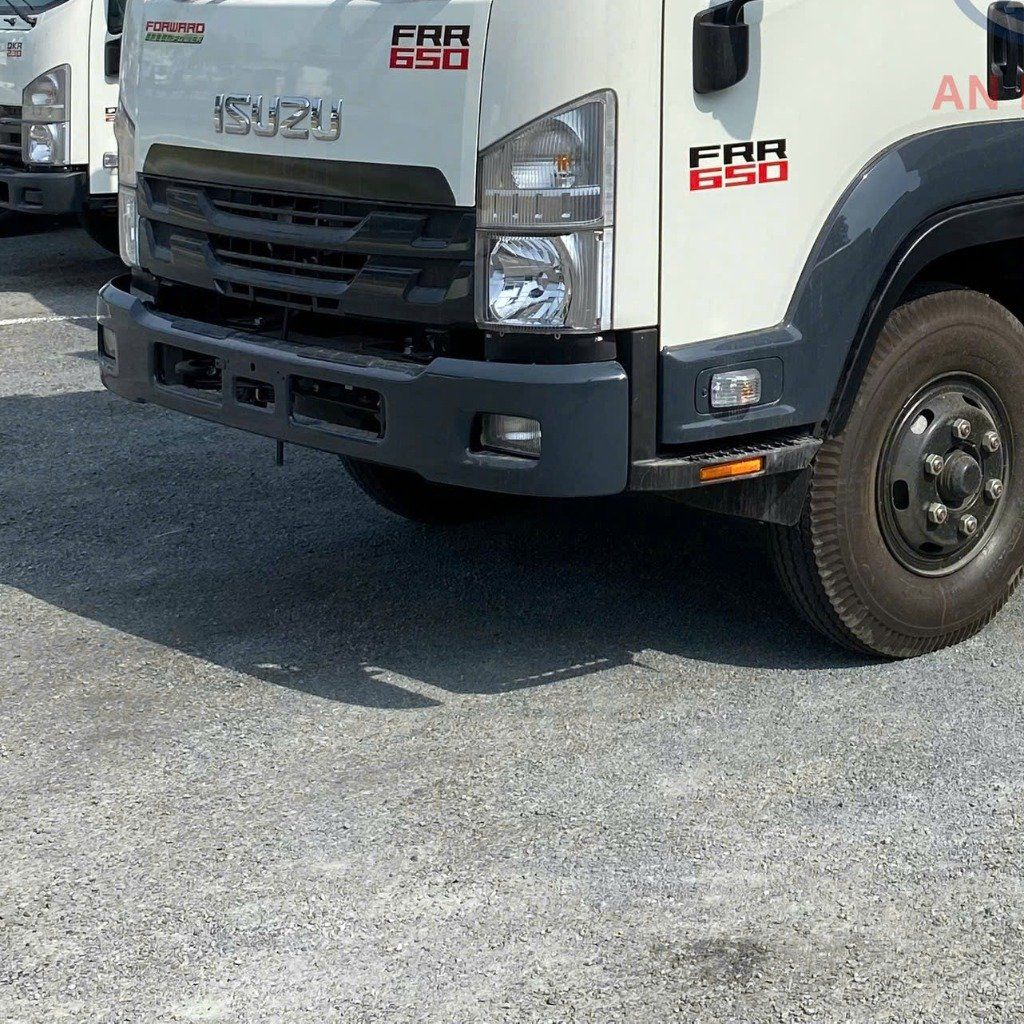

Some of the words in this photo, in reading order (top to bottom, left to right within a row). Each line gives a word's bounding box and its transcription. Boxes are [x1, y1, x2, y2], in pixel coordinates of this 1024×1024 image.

[145, 21, 205, 33] FORWARD
[391, 24, 470, 47] FRR
[389, 47, 470, 70] 650
[213, 94, 342, 141] ISUZU
[689, 138, 787, 168] FRR
[689, 160, 788, 191] 650
